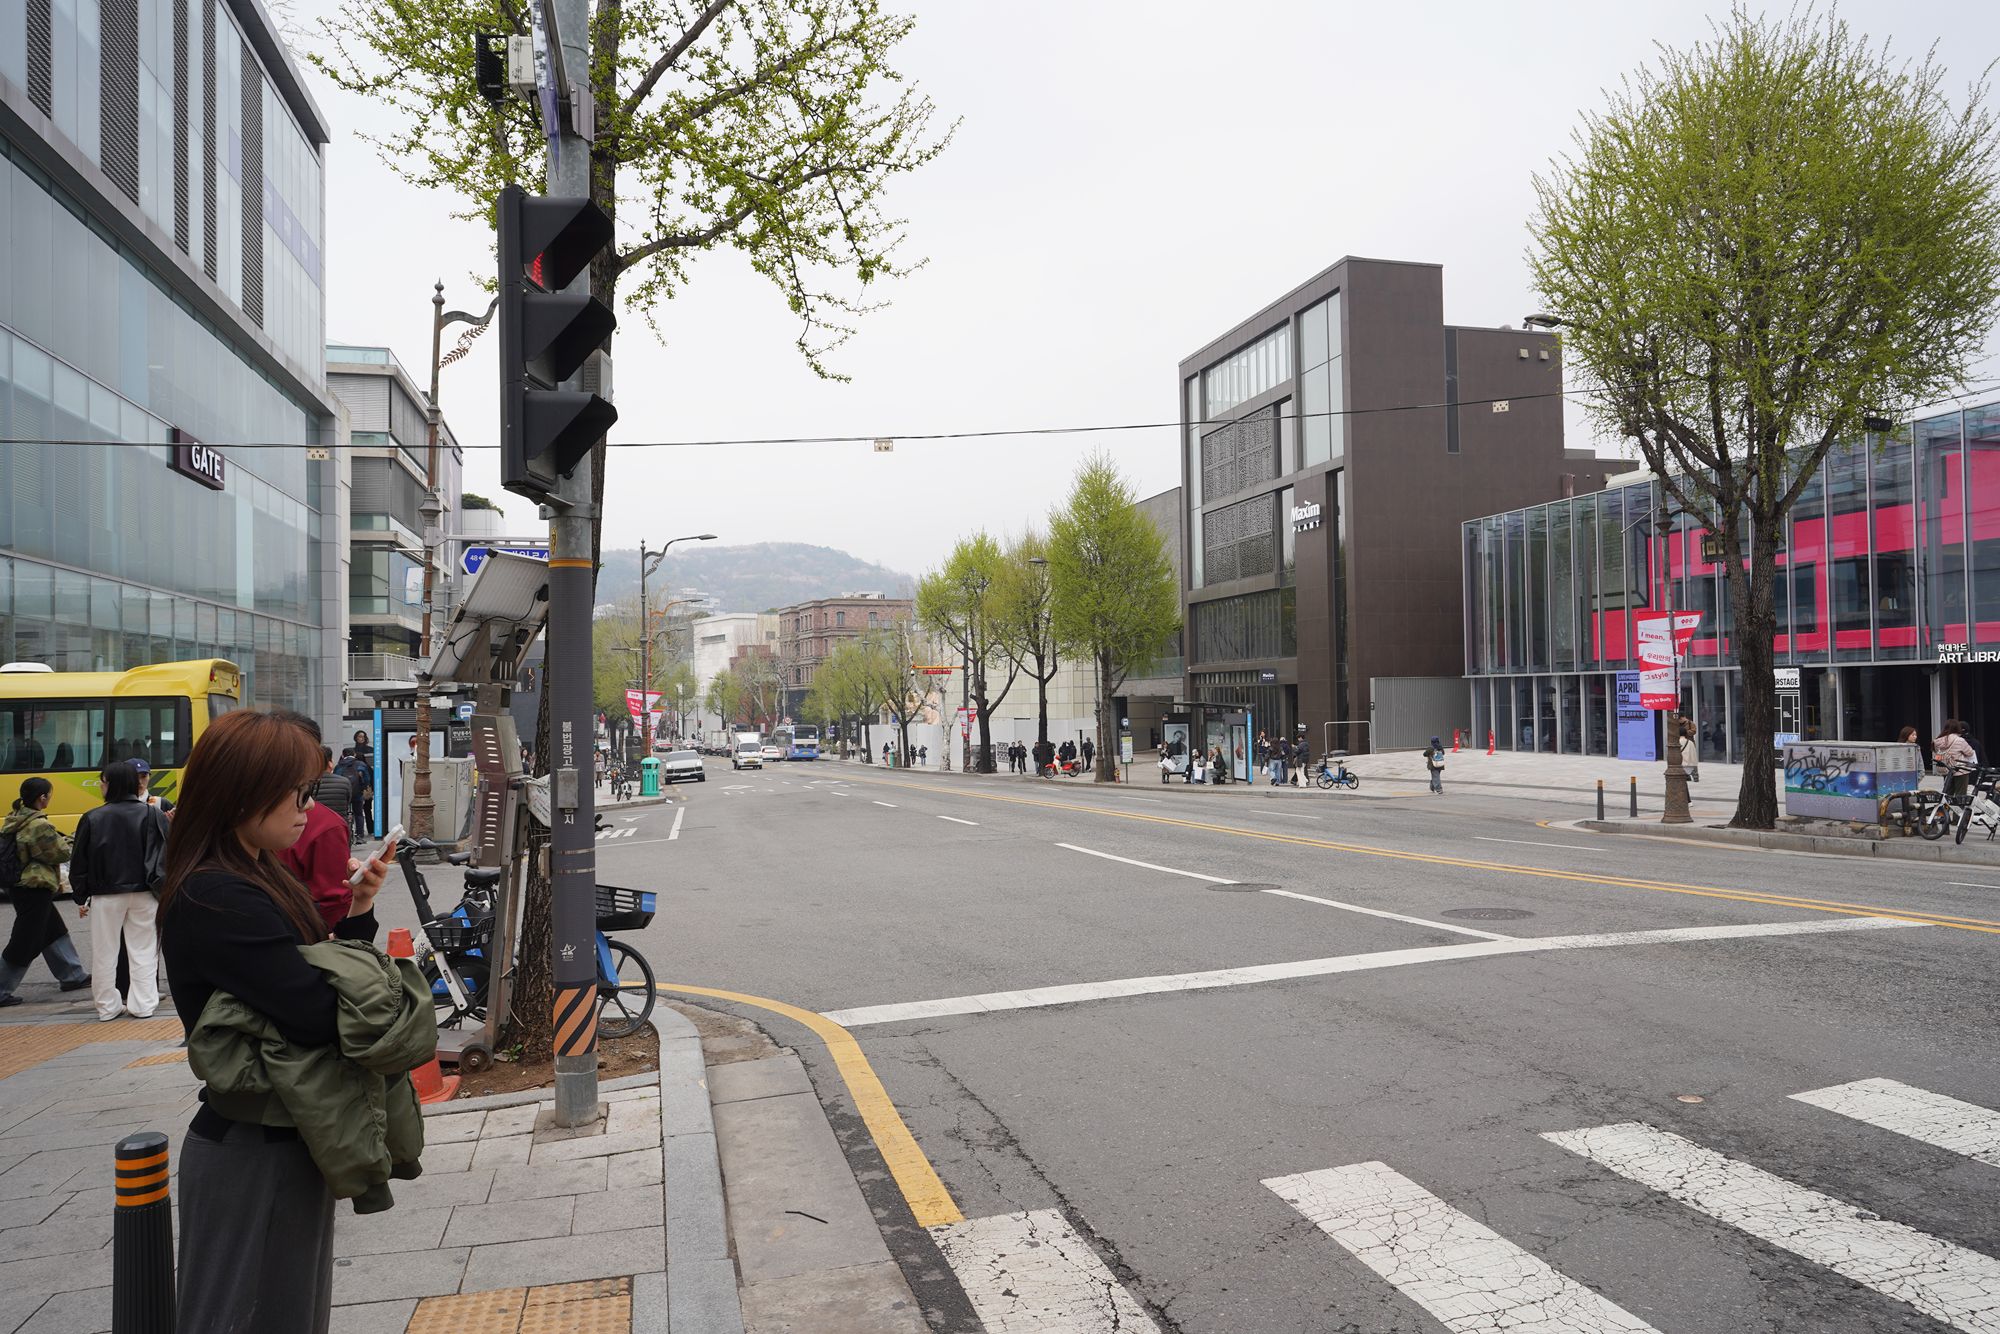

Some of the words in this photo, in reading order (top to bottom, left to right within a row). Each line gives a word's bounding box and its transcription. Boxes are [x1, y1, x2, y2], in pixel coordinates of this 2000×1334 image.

[191, 442, 221, 482] GATE
[1291, 500, 1320, 522] Maxim
[1292, 520, 1320, 534] PLANT
[1938, 643, 1968, 652] 현대카드
[1646, 652, 1672, 662] 우리만의
[1938, 652, 1964, 663] ART
[1618, 682, 1640, 693] APRIL
[1775, 678, 1798, 686] RSTAGE
